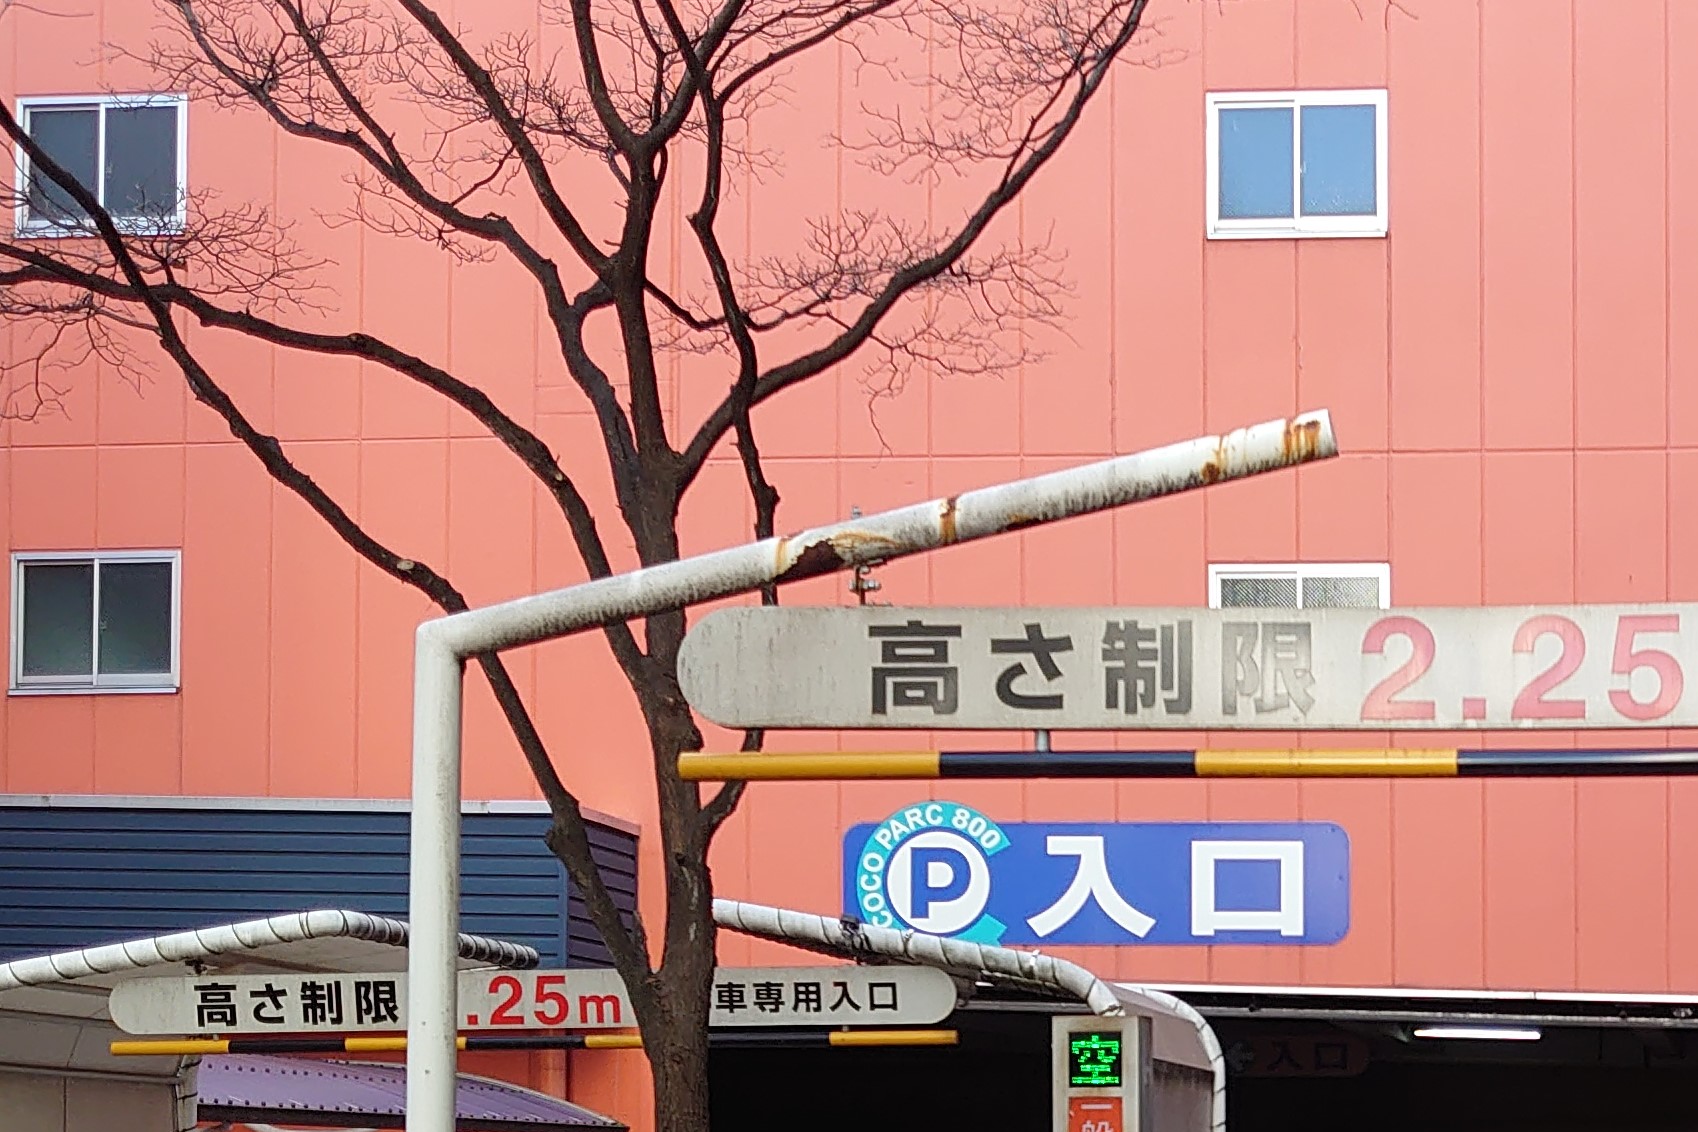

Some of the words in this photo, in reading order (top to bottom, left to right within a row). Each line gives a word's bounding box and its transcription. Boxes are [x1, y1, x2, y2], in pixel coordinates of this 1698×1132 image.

[868, 619, 1317, 717] 高さ制限
[874, 804, 943, 850] PARC
[951, 808, 1001, 849] 800
[860, 852, 893, 928] COCO
[910, 847, 972, 919] P
[1027, 835, 1304, 938] 入口
[193, 980, 399, 1027] 高さ制限
[466, 975, 621, 1025] .25m
[1072, 1035, 1119, 1084] 空
